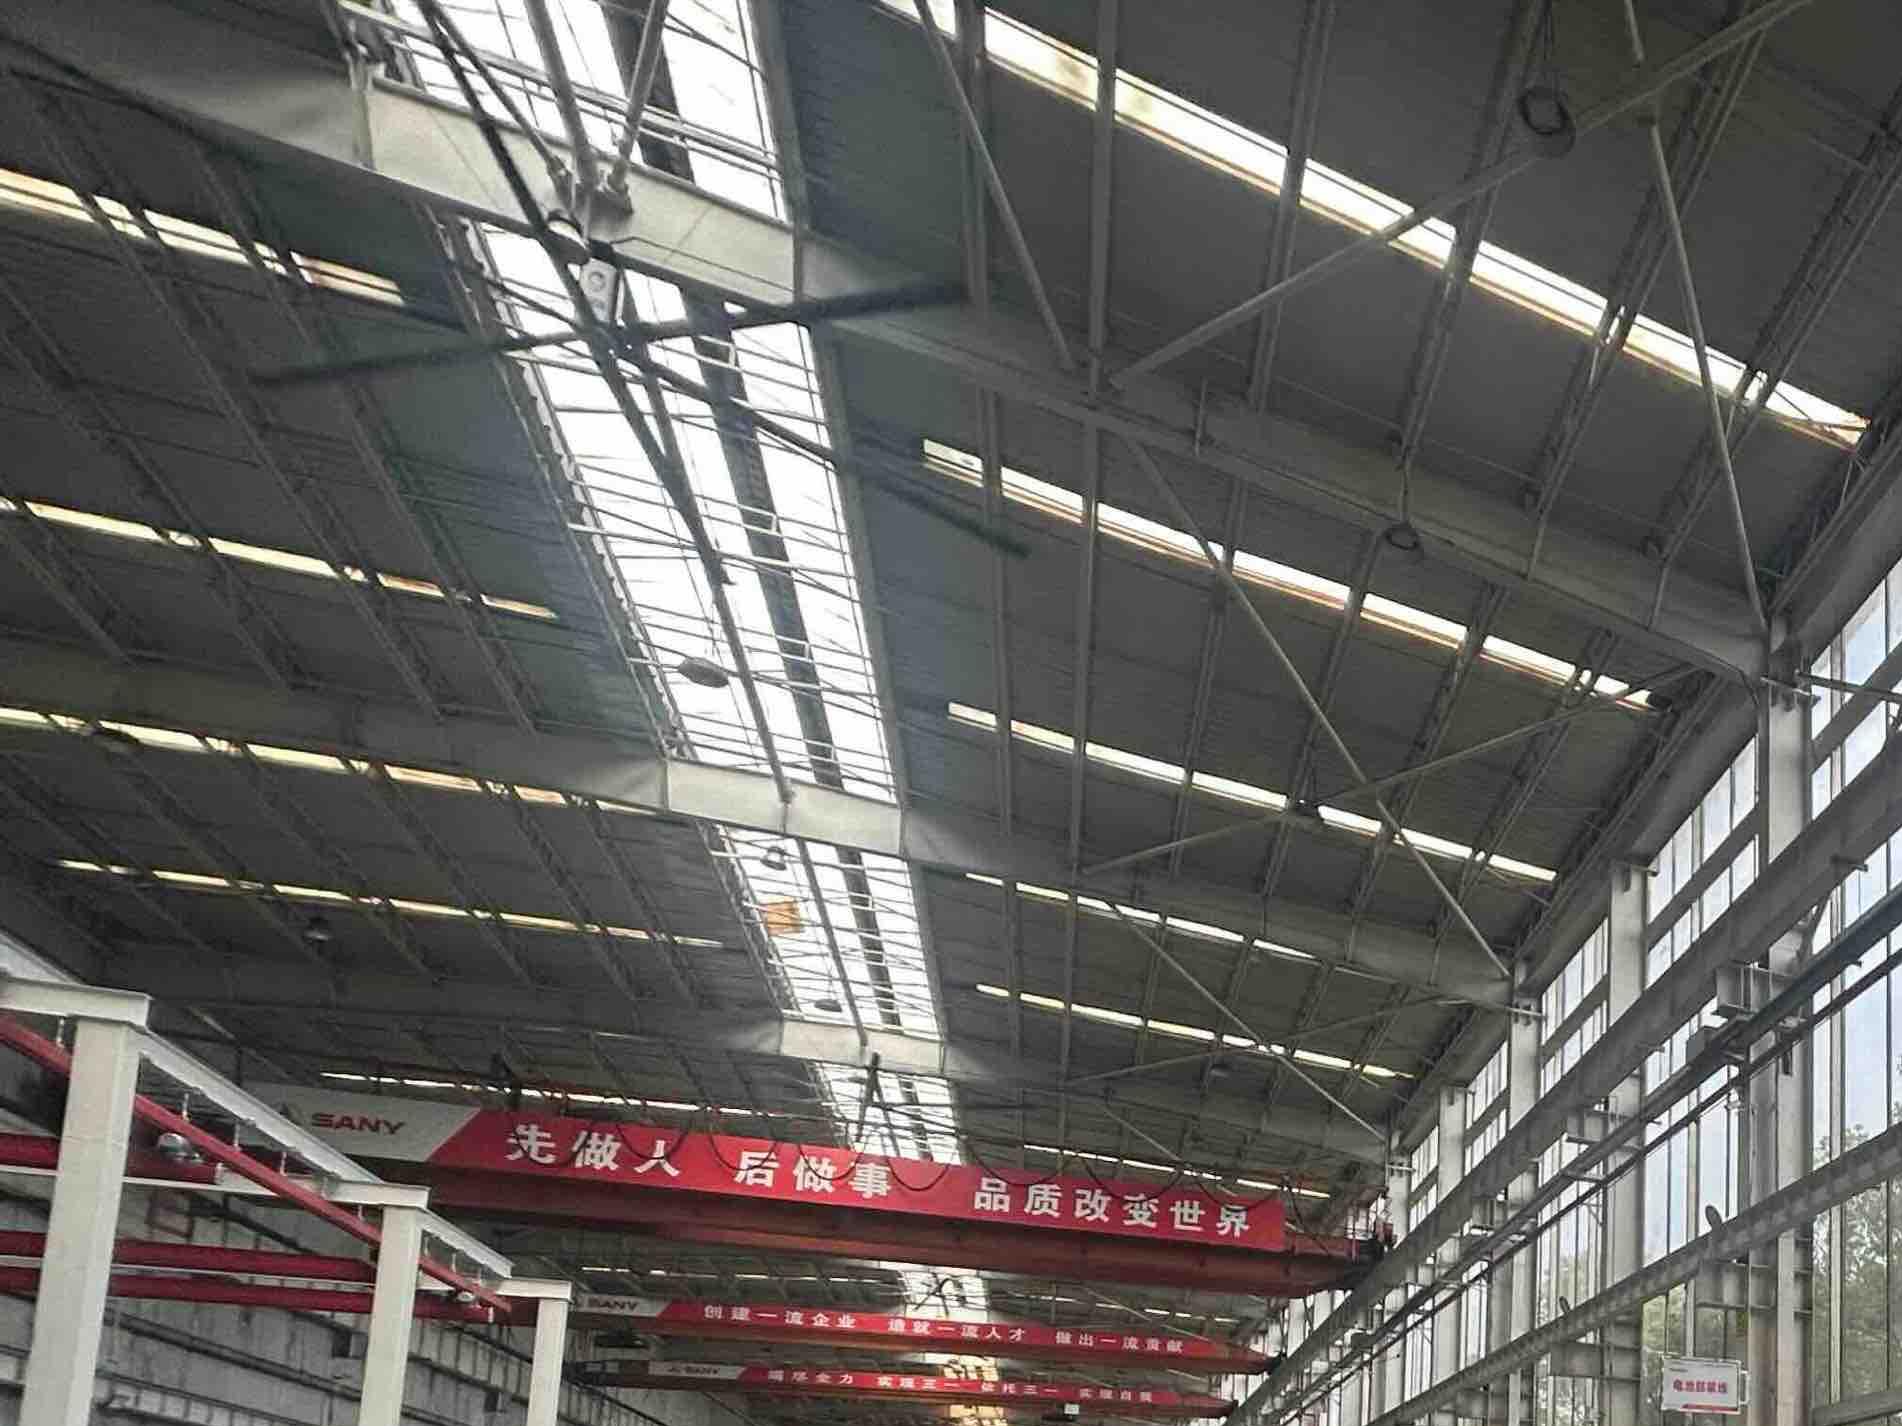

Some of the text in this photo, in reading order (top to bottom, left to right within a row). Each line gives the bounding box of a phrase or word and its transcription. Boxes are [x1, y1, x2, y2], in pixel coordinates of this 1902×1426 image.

[311, 1112, 406, 1136] SANY
[505, 1122, 1251, 1238] 先做人 后做事 品质改变世界
[703, 1303, 857, 1329] 创建一流企业
